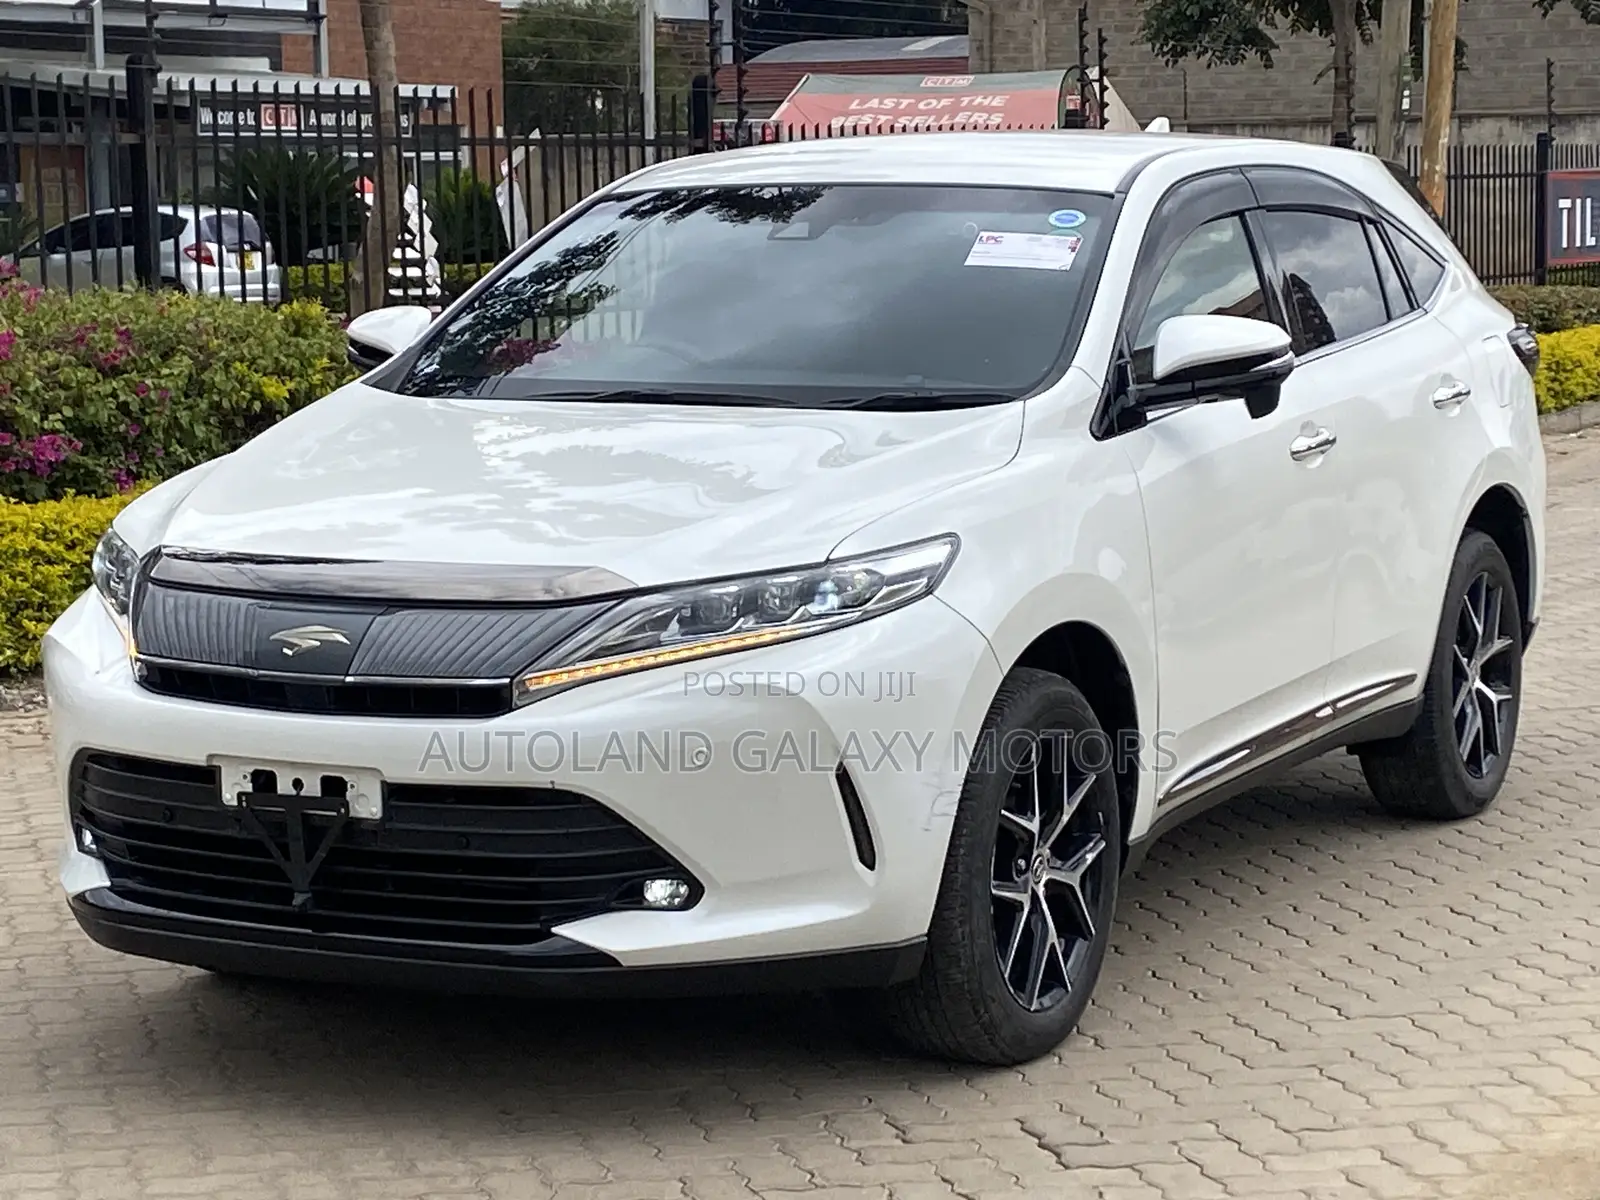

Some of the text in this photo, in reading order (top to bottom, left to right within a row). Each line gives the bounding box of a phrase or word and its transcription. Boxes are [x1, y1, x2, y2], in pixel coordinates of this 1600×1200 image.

[924, 77, 972, 87] CTM
[849, 95, 1010, 110] LAST OF THE
[309, 109, 317, 126] A
[831, 112, 1005, 128] BEST SELLERS
[1558, 197, 1596, 249] TIL
